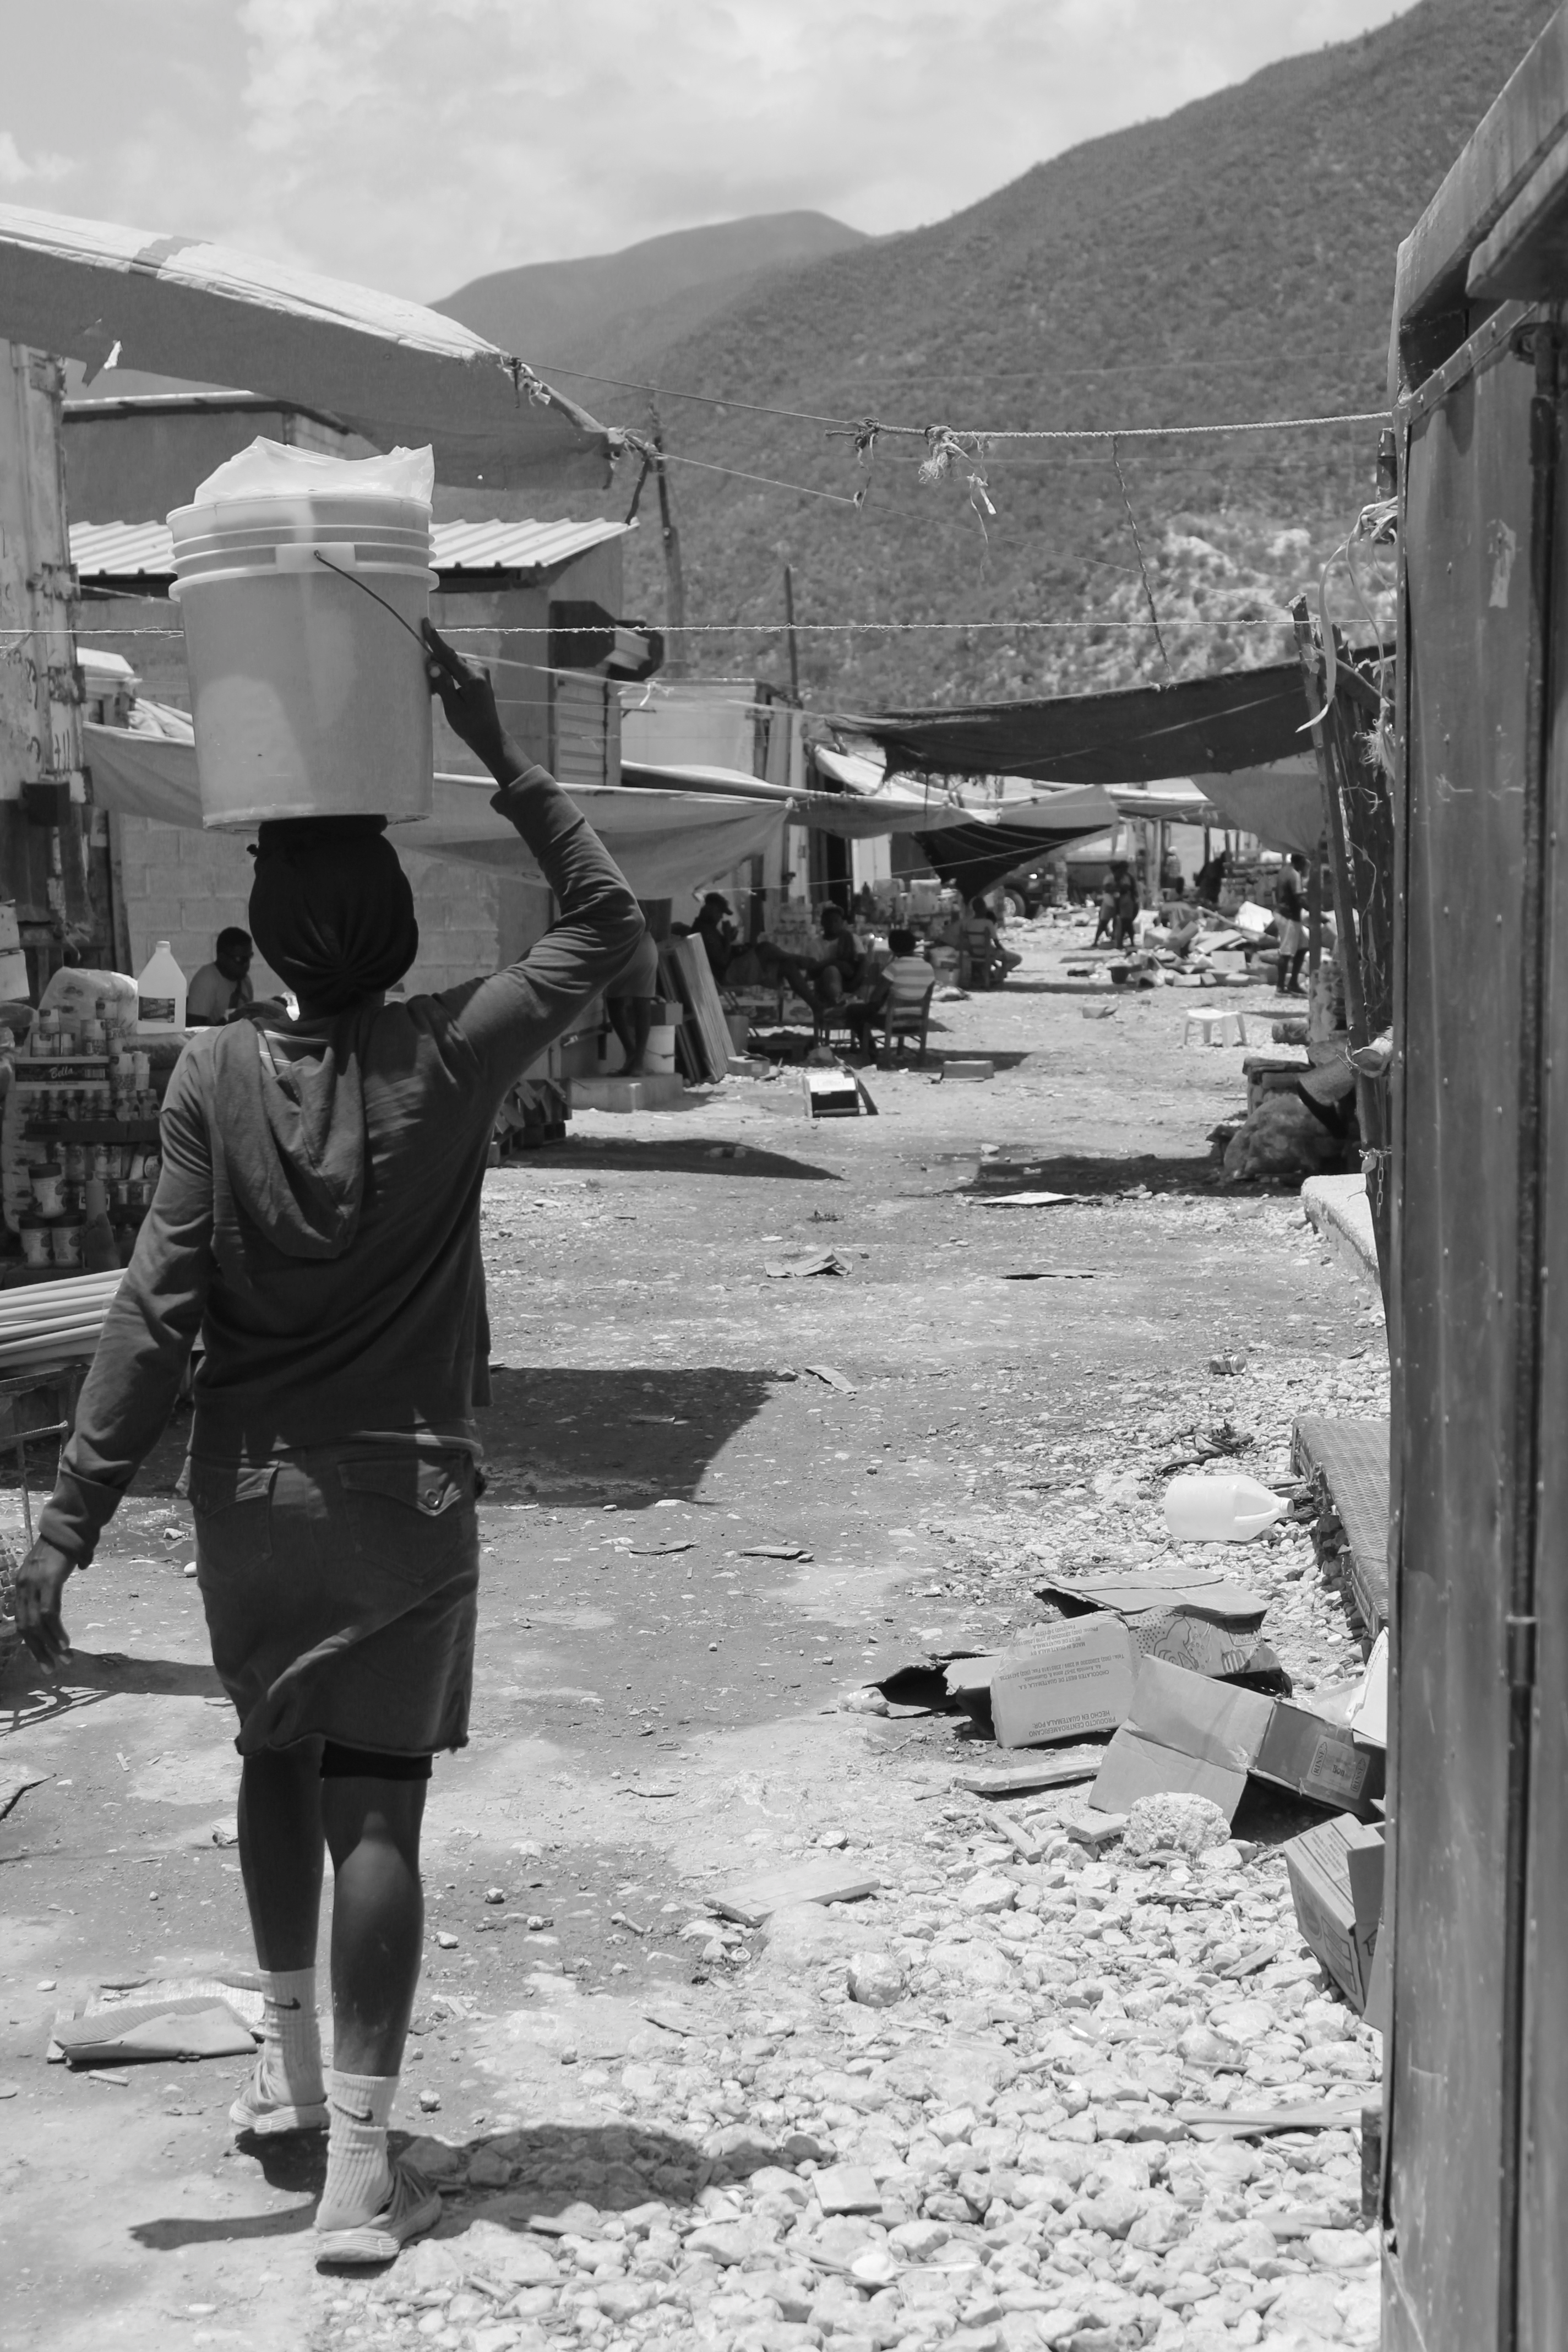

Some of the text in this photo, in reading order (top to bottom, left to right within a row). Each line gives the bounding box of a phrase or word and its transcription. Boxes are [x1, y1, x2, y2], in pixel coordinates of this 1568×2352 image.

[1032, 1640, 1061, 1649] GUATEMALA
[1037, 1645, 1066, 1654] GUATEMALA
[1078, 1669, 1109, 1679] CHOCOLATES
[1090, 1709, 1110, 1718] HECHO
[1046, 1715, 1080, 1726] GUATEMALA
[1028, 1716, 1115, 1737] PRODUCTO CENTROAMERICANO
[1314, 1749, 1326, 1774] RINSE
[1353, 1765, 1365, 1790] RINSE
